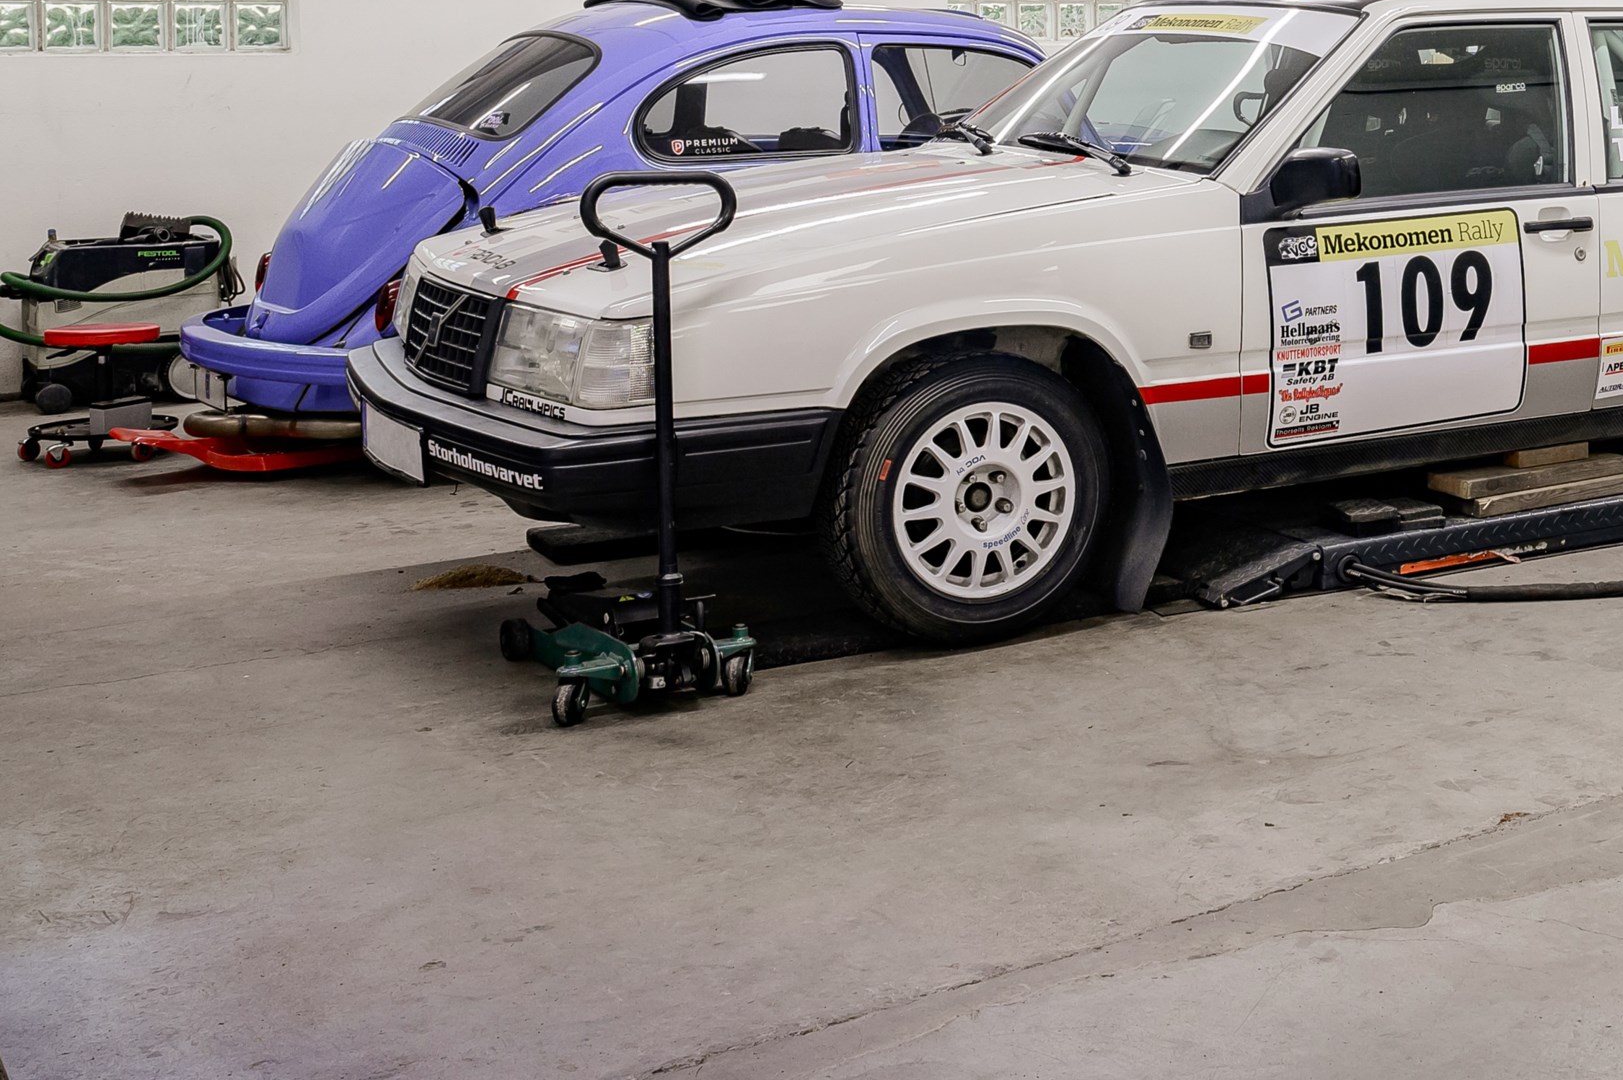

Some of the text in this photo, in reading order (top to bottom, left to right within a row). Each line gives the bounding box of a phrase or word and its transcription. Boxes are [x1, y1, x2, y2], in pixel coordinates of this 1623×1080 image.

[1149, 17, 1224, 29] Mekonomen
[1496, 82, 1526, 93] sparco
[685, 138, 738, 148] PREMIUM
[695, 147, 731, 155] CLASSIC
[1323, 220, 1504, 255] Mekonomen Rally
[1356, 250, 1493, 354] 109
[1305, 305, 1338, 317] PARTNERS
[1280, 321, 1341, 339] Hellmans
[1276, 344, 1341, 361] KNUTTEMOTORSPORT
[1297, 358, 1339, 377] KBT
[1286, 374, 1335, 386] Safety AB
[1300, 403, 1320, 415] JB
[1299, 411, 1339, 422] ENGINE
[428, 439, 544, 490] Storholmsvarvet
[982, 526, 1022, 549] speedline
